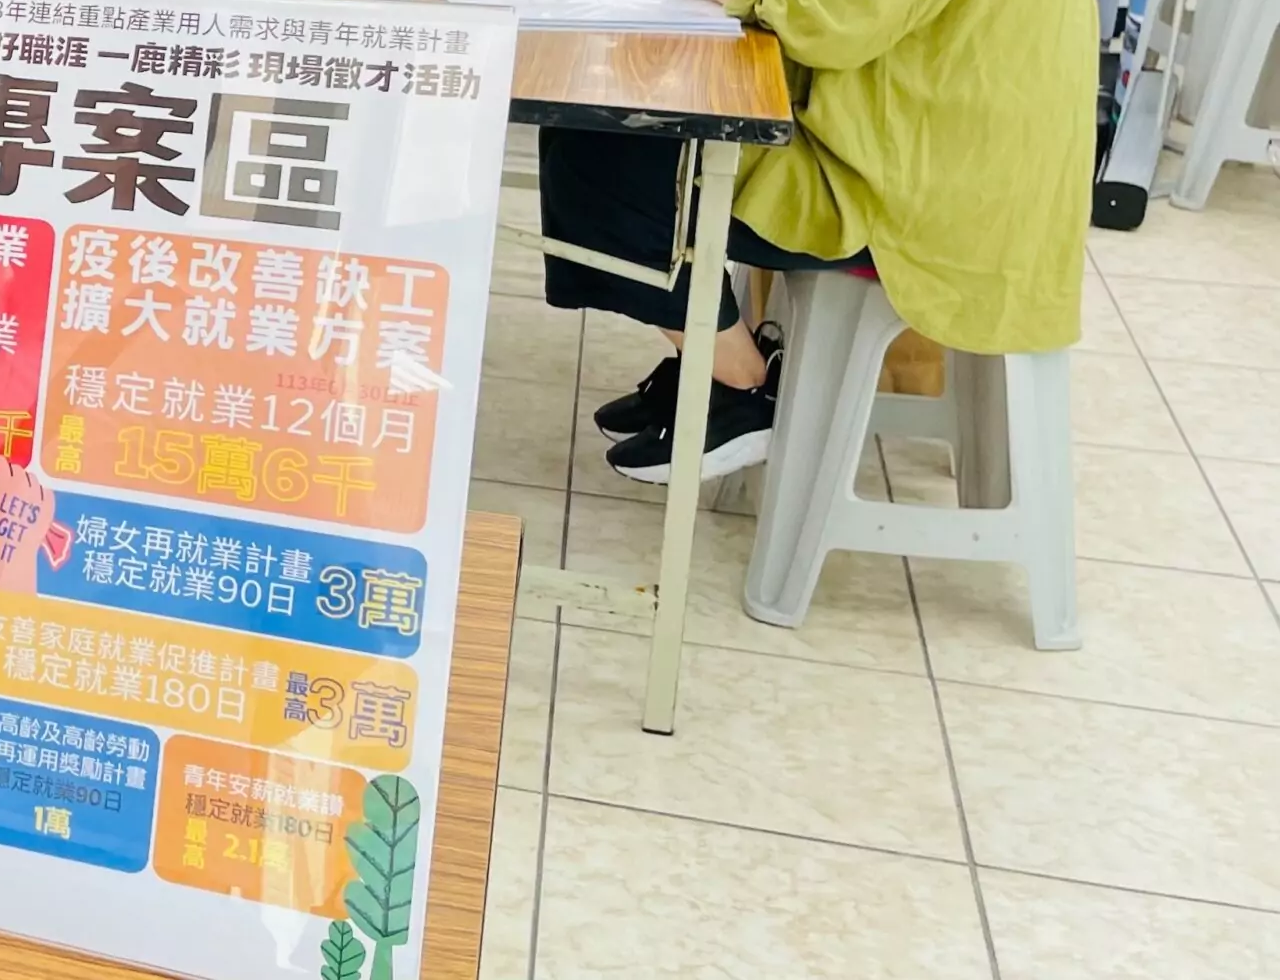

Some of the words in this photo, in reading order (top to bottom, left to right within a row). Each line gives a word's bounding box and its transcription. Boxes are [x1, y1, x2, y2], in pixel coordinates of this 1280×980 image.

[98, 41, 240, 80] 一鹿精彩
[247, 51, 481, 100] 現場徵才活動
[67, 229, 436, 317] 疫後改善缺工
[60, 280, 432, 368] 擴大就業方案
[63, 362, 417, 454] 穩定就業12個月
[55, 414, 85, 475] 最高
[0, 492, 41, 523] LET'S
[1, 546, 17, 563] IT
[75, 513, 315, 584] 婦女再就業計畫
[82, 548, 295, 618] 穩定就業90日
[316, 564, 423, 638] 3萬
[3, 644, 247, 725] 穩定就業180日
[284, 671, 309, 723] 最高
[306, 676, 412, 749] 3萬
[183, 763, 344, 818] 青年安薪就業讚
[185, 792, 334, 846] 穩定就業180日
[33, 805, 73, 841] 1萬
[182, 817, 208, 870] 最高
